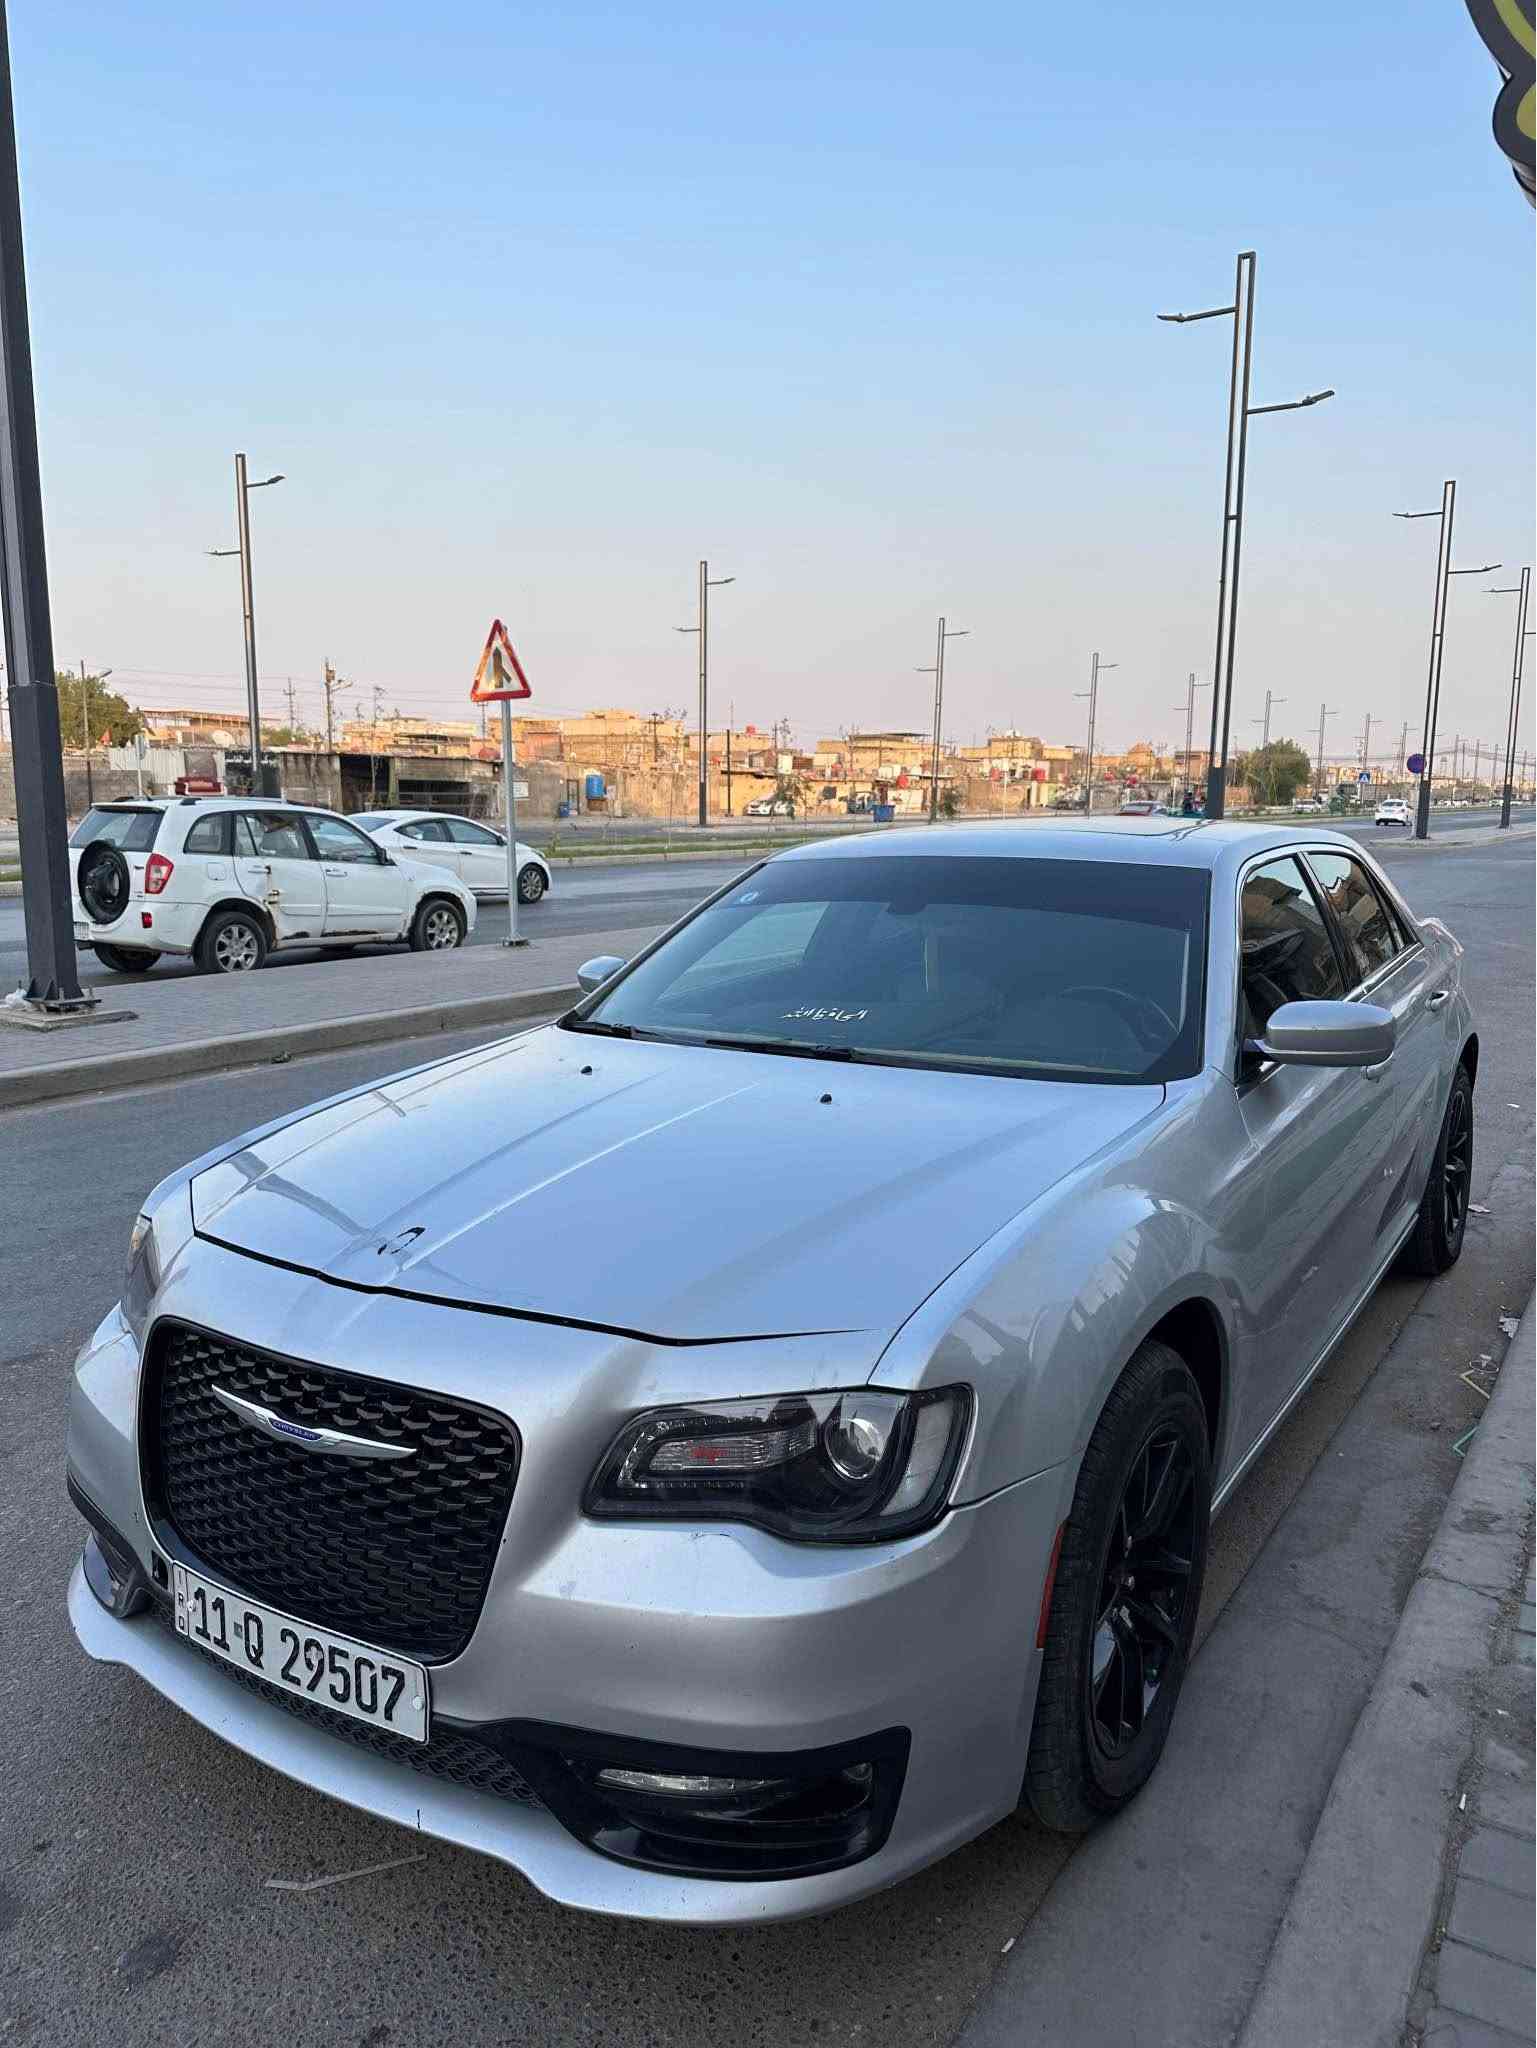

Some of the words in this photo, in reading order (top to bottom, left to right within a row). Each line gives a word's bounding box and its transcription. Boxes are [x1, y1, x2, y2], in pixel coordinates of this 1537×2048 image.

[194, 1586, 230, 1652] 11
[243, 1611, 264, 1670] Q
[280, 1628, 405, 1721] 29507
